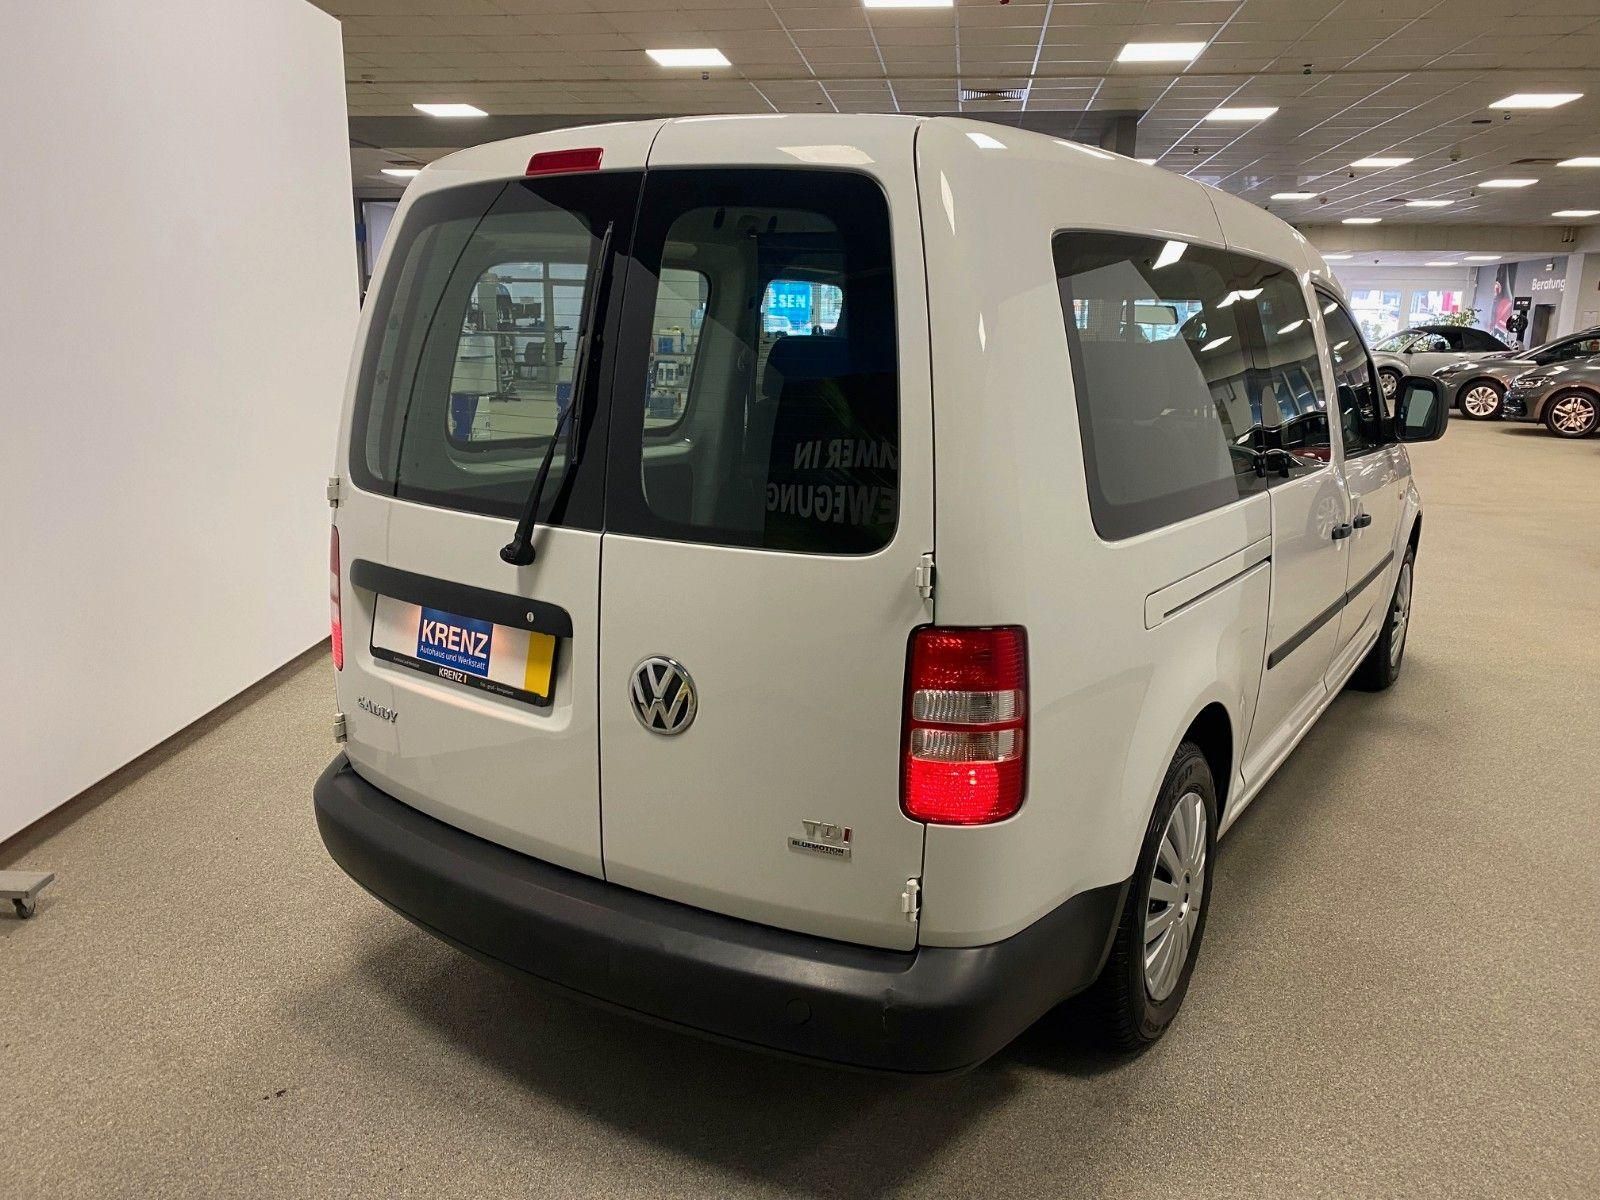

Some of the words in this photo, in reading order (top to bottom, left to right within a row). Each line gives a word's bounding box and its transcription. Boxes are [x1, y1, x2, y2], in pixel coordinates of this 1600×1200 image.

[1532, 278, 1566, 291] Beratung
[421, 619, 488, 659] KRENZ
[420, 645, 445, 660] Autohaus
[445, 653, 457, 661] und
[458, 655, 486, 670] Werkstatt
[438, 667, 462, 682] KRENZ
[802, 819, 852, 844] TDI
[792, 840, 844, 855] BLUEMOTION
